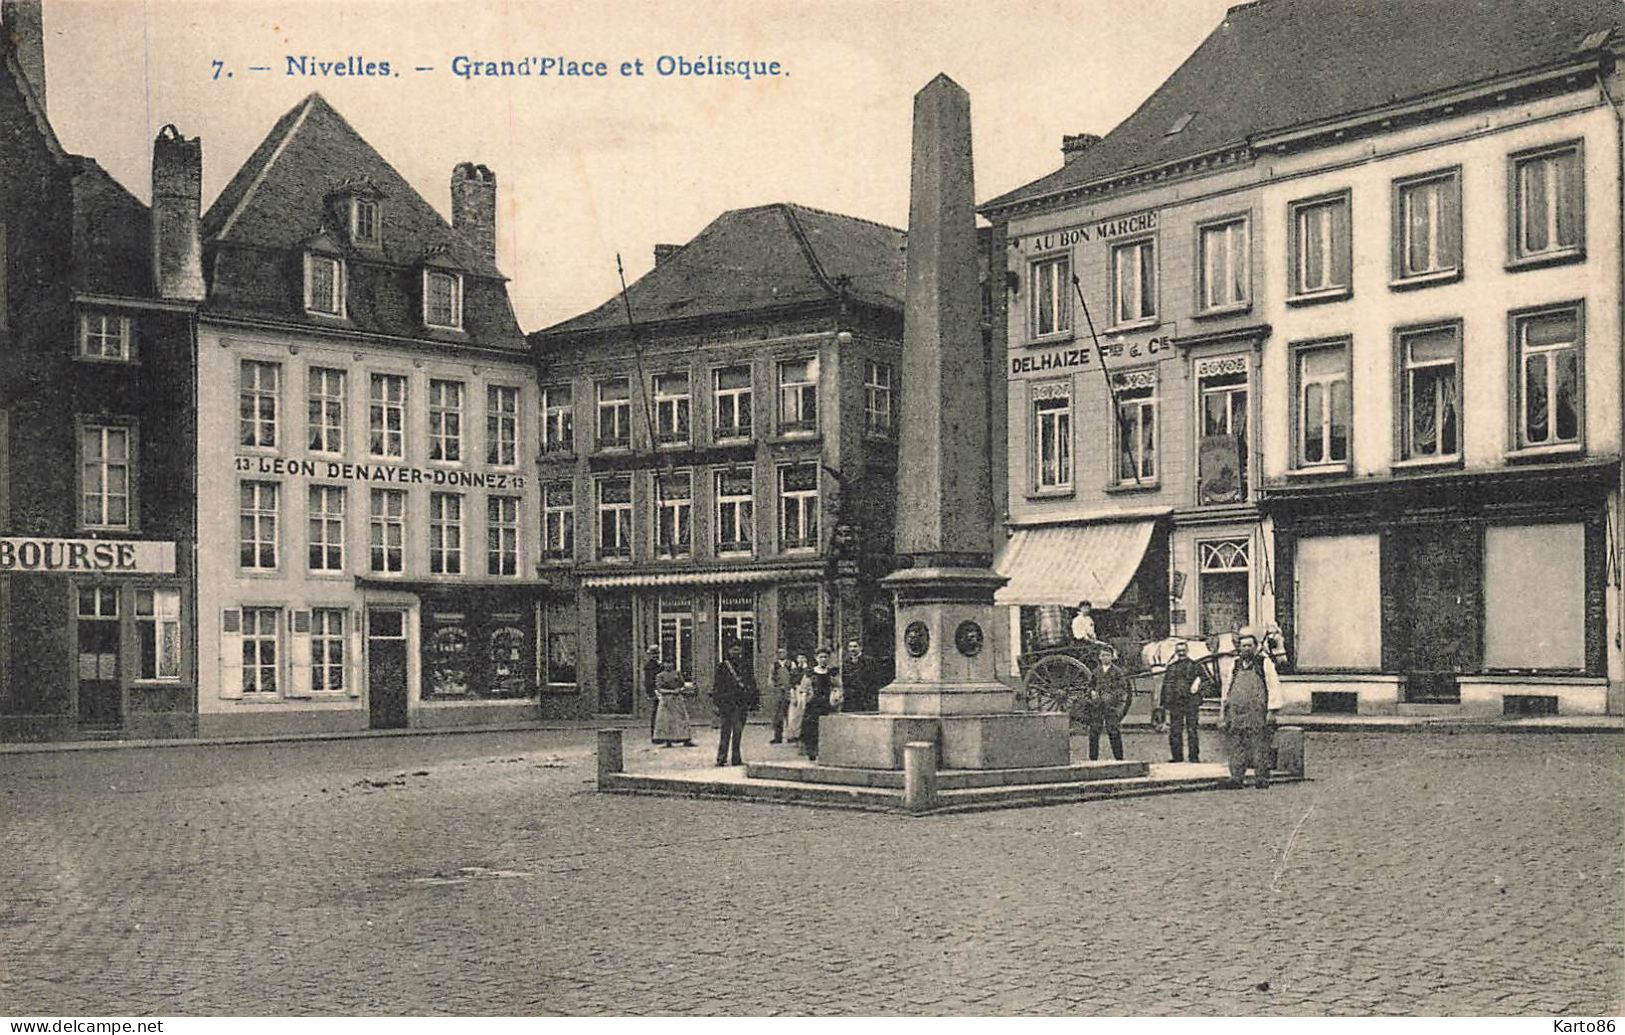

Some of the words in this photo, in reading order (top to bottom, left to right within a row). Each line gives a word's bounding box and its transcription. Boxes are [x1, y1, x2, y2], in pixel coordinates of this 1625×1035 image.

[1034, 234, 1055, 251] AU
[1060, 229, 1090, 247] BON
[1011, 348, 1090, 374] DELHAIZE
[1129, 343, 1142, 358] &
[258, 458, 316, 477] LEON
[0, 540, 136, 570] BOURSE
